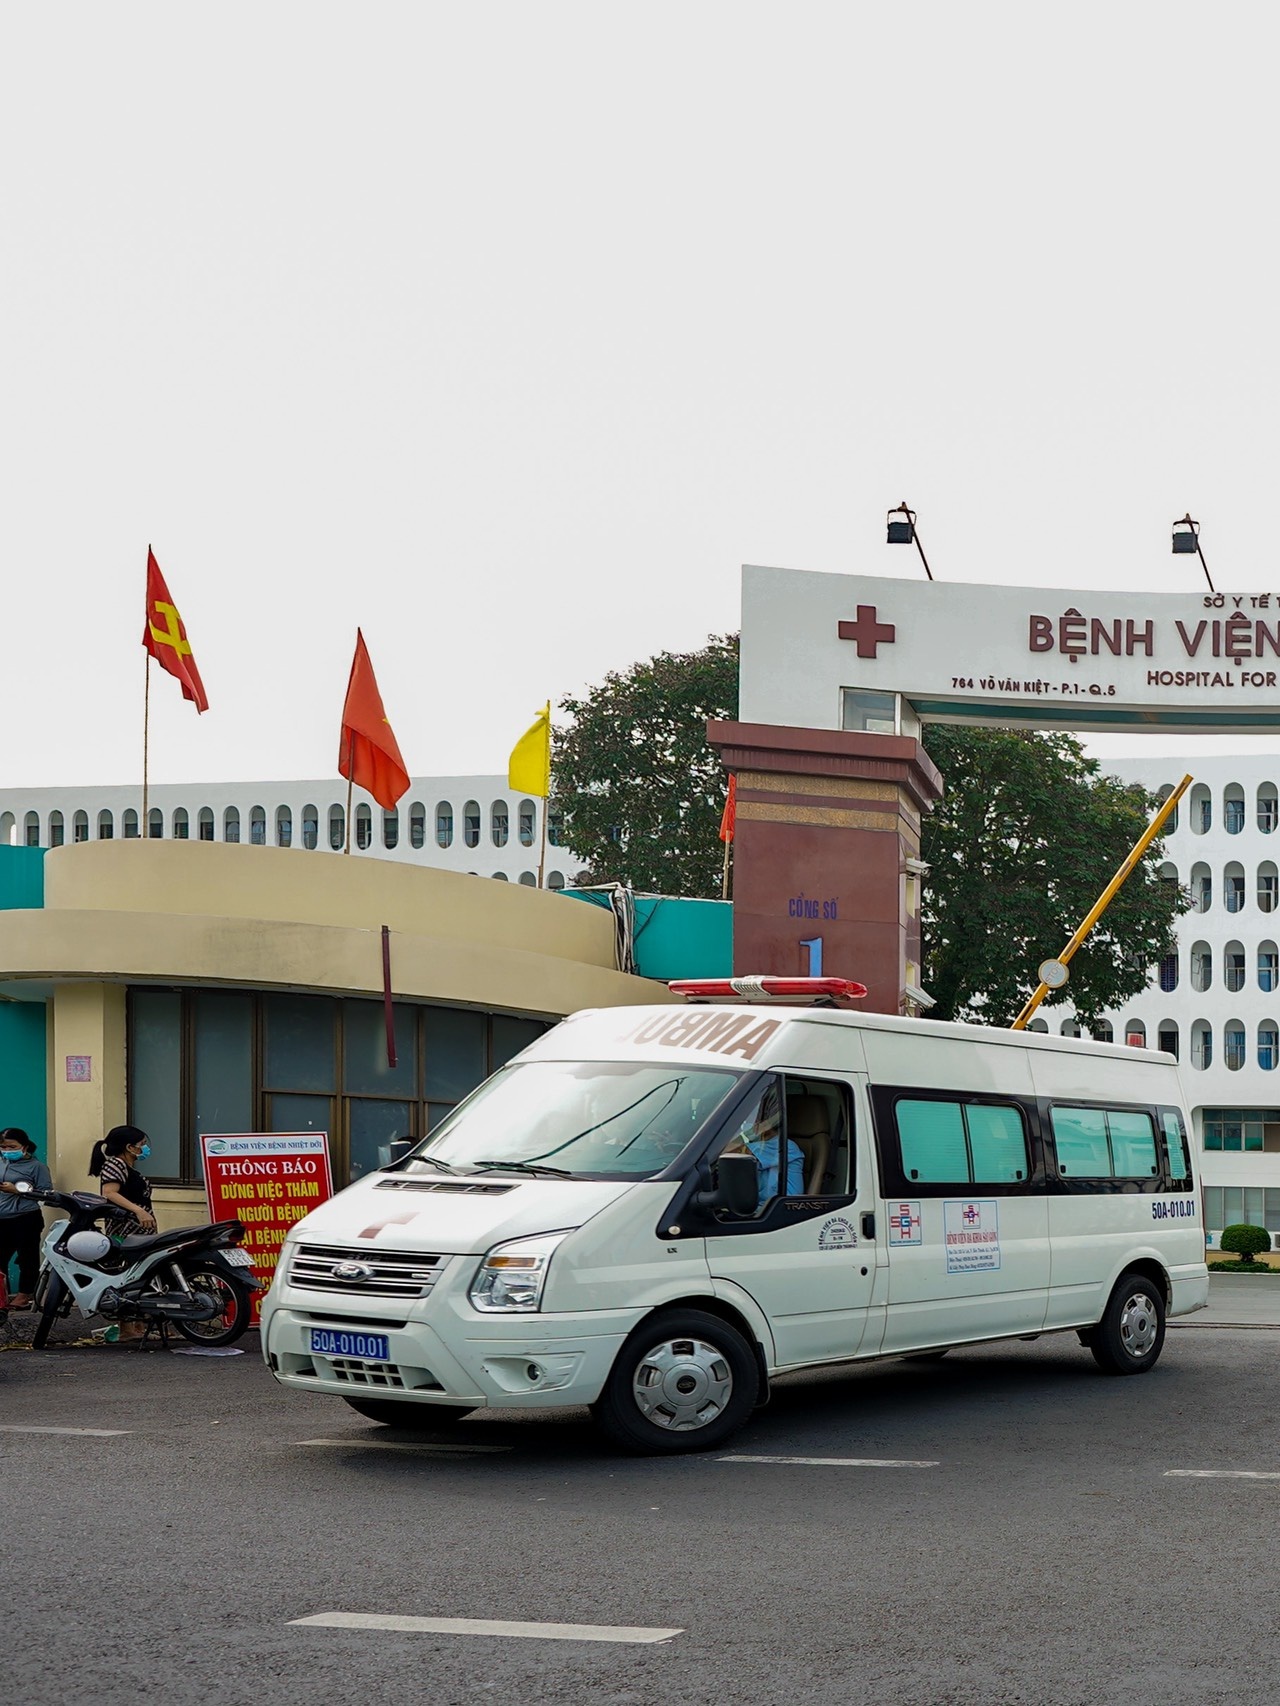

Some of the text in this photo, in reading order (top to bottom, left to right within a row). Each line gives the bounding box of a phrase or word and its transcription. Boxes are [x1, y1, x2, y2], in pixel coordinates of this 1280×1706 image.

[1203, 592, 1225, 608] SỞ
[1232, 597, 1243, 608] Y
[1250, 593, 1272, 608] TẾ
[1029, 607, 1153, 663] BỆNH
[951, 677, 974, 689] 764
[979, 675, 996, 690] VÕ
[998, 678, 1020, 692] VĂN
[1024, 679, 1050, 695] KIỆT
[1146, 670, 1235, 687] HOSPITAL
[1241, 671, 1277, 687] FOR
[822, 897, 839, 920] SỐ
[799, 936, 823, 977] 1
[218, 1157, 317, 1176] THÔNG BÁO
[221, 1179, 319, 1201] DỪNG VIỆC THĂM
[237, 1203, 308, 1224] NGƯỜI BỆNH
[784, 1201, 830, 1210] TRANSIT
[1151, 1200, 1195, 1220] 50A-010.01
[248, 1249, 280, 1268] HÒN
[313, 1330, 383, 1357] 50A-010.01
